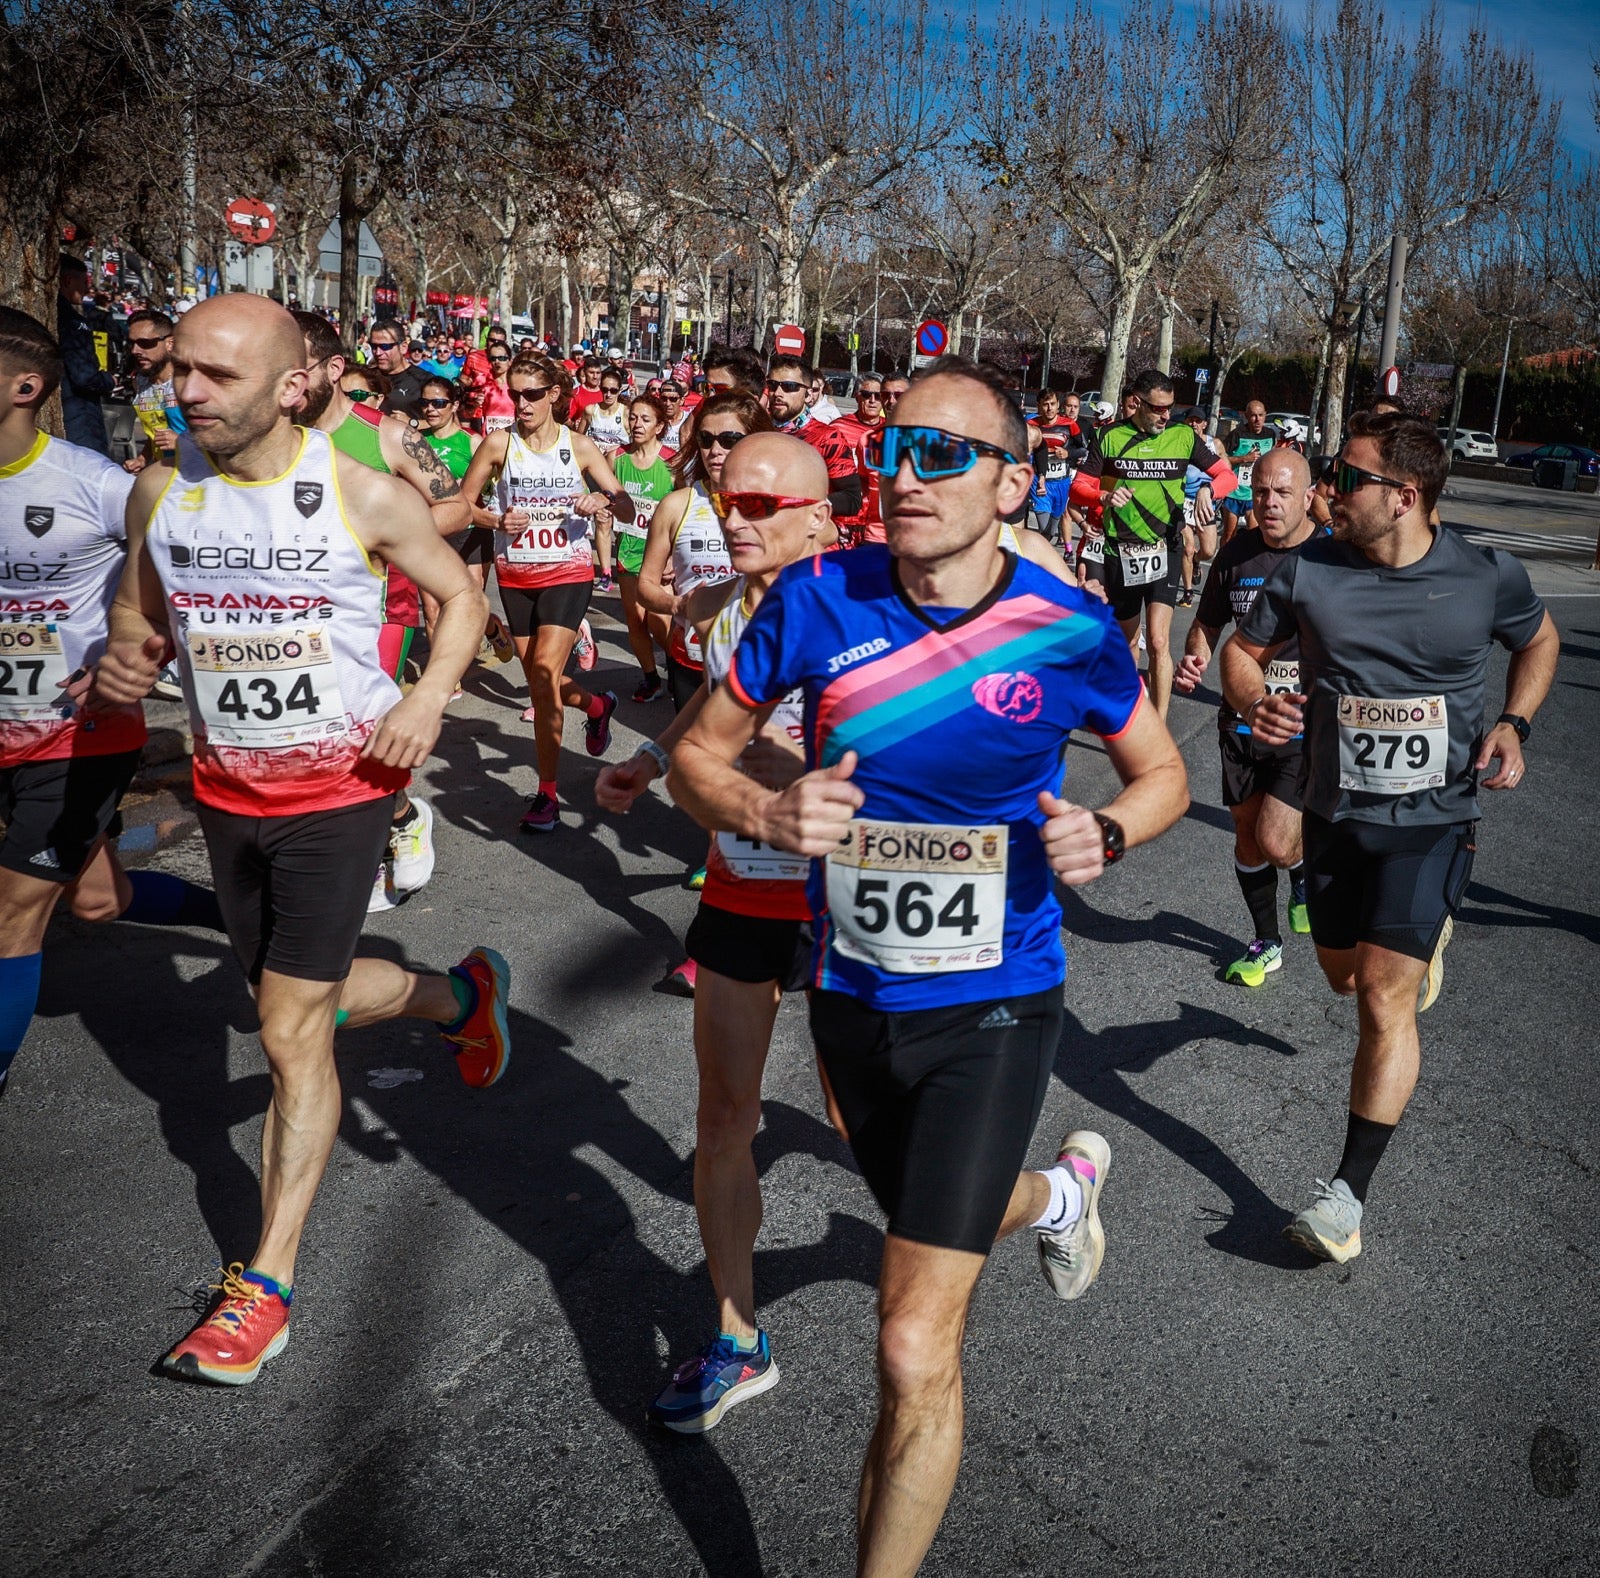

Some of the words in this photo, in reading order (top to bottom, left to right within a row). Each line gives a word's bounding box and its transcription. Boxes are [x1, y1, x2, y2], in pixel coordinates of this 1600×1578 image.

[1114, 460, 1139, 470] CAJA
[1143, 461, 1179, 470] RURAL
[1129, 555, 1161, 575] 570
[169, 592, 334, 610] GRANADA
[177, 607, 333, 624] RUNNERS
[214, 641, 302, 662] FONDO
[217, 673, 321, 721] 434
[1360, 707, 1424, 722] FONDO
[1353, 733, 1430, 769] 279
[864, 836, 972, 861] FONDO
[853, 879, 980, 938] 564
